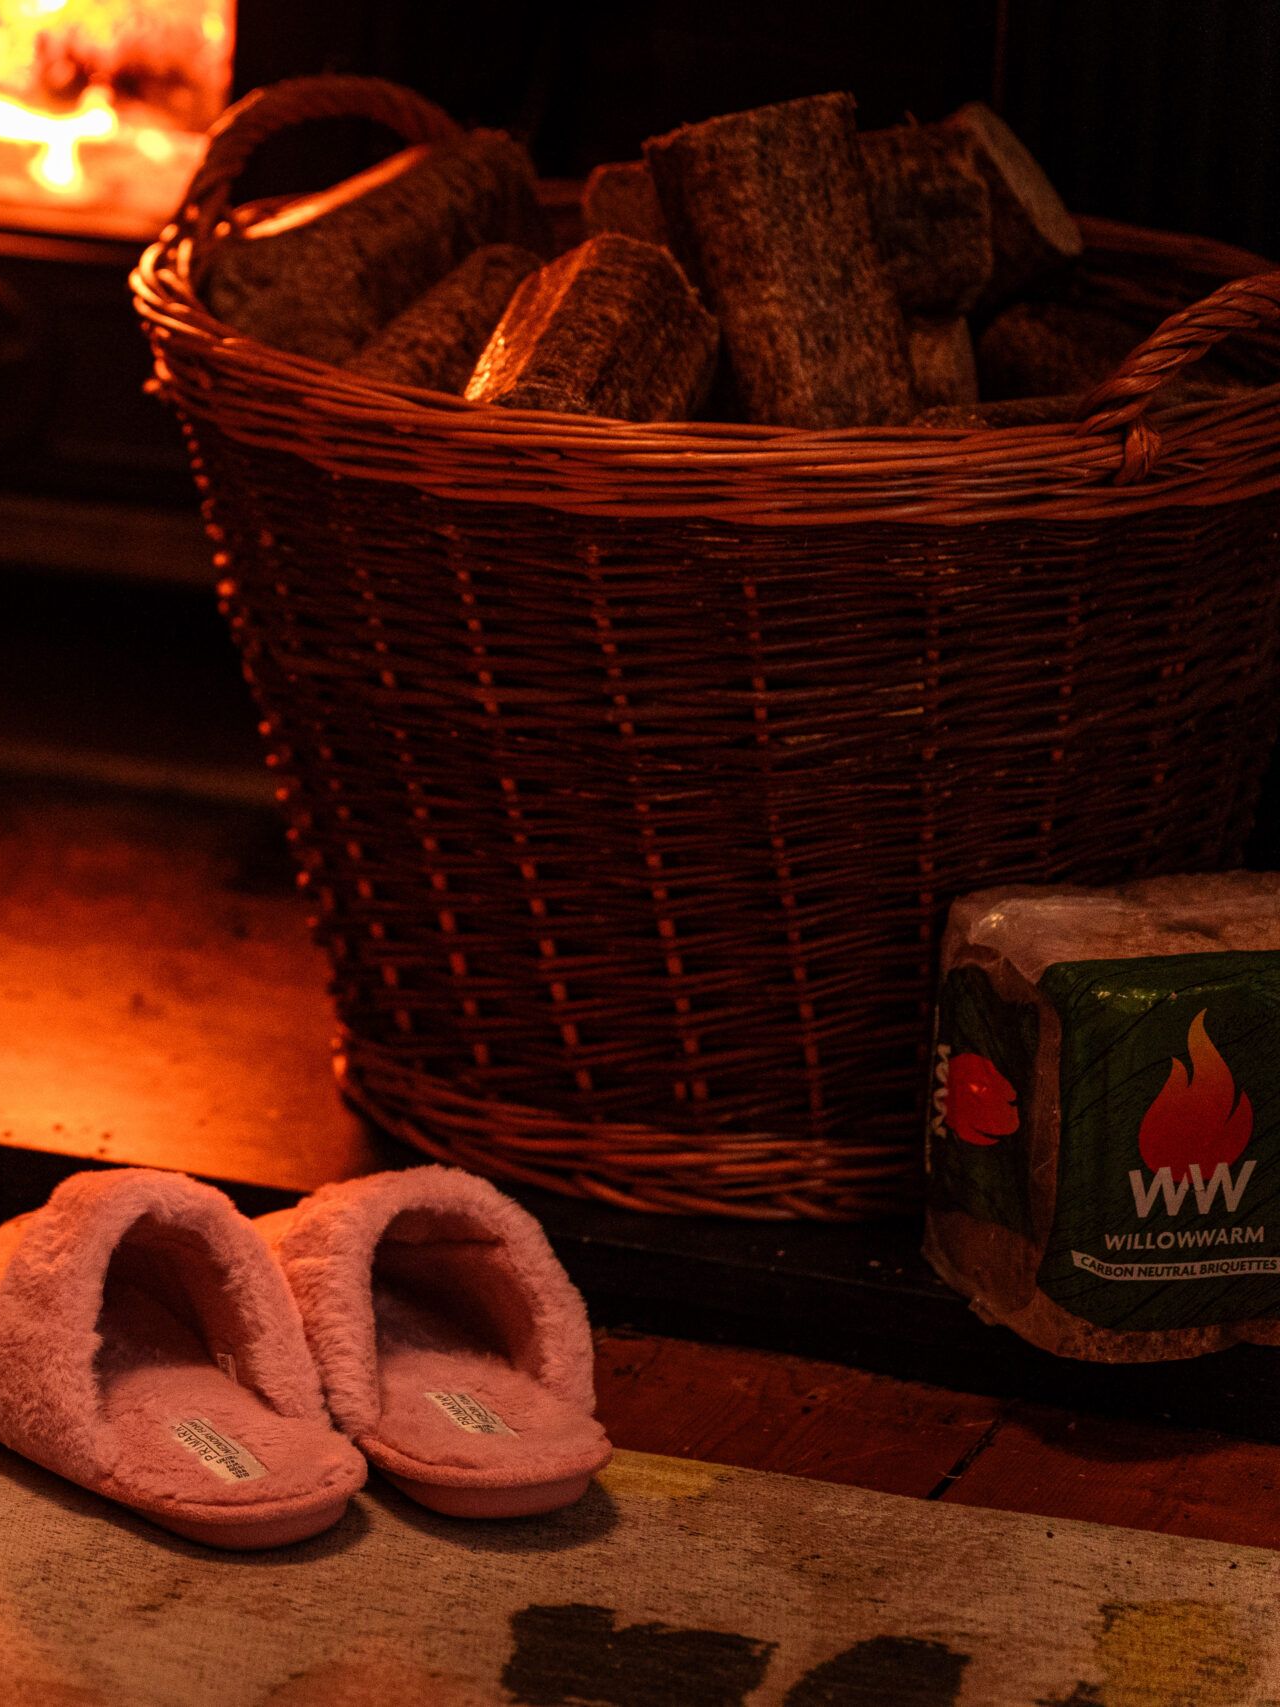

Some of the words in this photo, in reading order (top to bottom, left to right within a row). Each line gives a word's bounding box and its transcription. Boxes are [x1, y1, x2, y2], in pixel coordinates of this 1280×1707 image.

[1128, 1160, 1258, 1219] WW
[1104, 1225, 1266, 1252] WILLOWWARM
[1081, 1256, 1134, 1279] CARBON
[1137, 1263, 1197, 1278] NEUTRAL
[1200, 1259, 1277, 1276] BRIQUETTES
